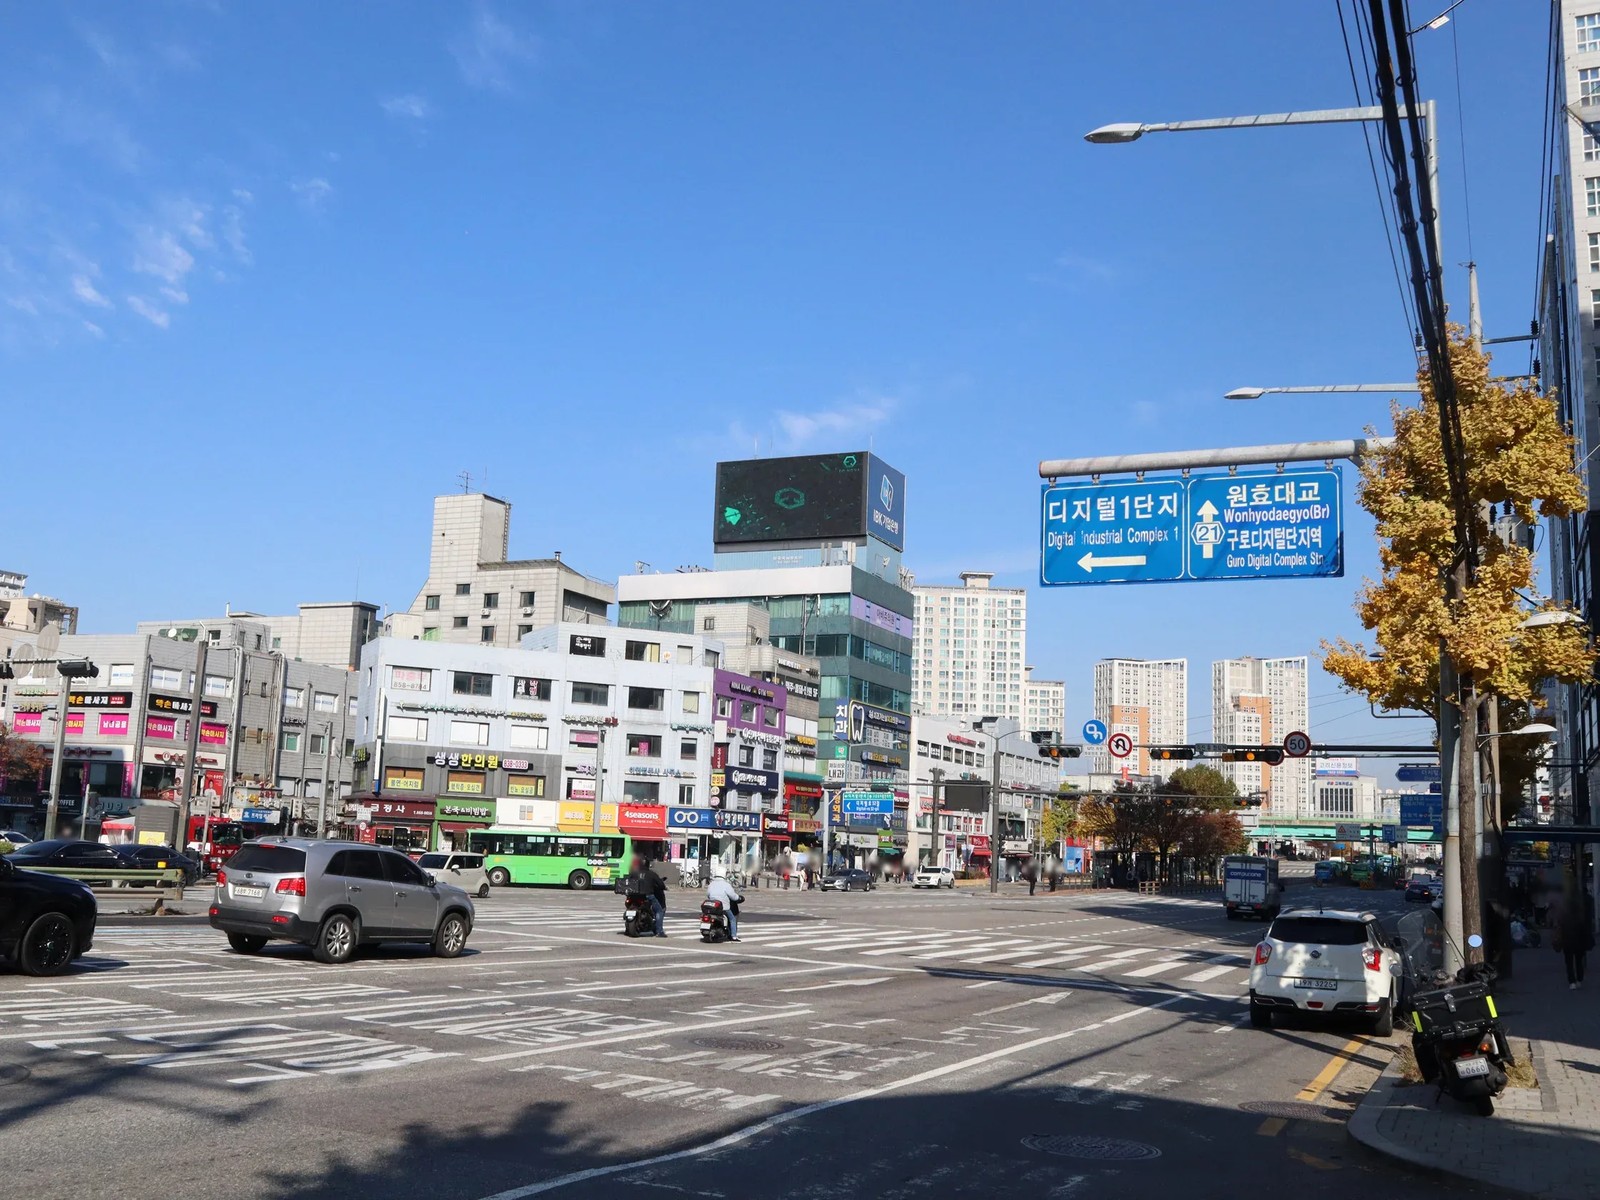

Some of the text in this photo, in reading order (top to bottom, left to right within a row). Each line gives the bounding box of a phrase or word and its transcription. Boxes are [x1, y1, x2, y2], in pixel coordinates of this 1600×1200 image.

[1226, 481, 1321, 508] 원효대교
[1049, 492, 1178, 523] 디지털1단지
[1223, 504, 1330, 525] Wonhyodaegyo(Br)
[1048, 526, 1179, 550] Digital Industrial Complex 1
[1200, 525, 1219, 541] 21
[1226, 526, 1322, 551] 구로디지털단지역
[1227, 554, 1245, 568] Guro
[1248, 552, 1272, 570] Digital
[1274, 551, 1307, 569] Complex
[835, 704, 849, 734] 치과
[1289, 738, 1306, 750] 50
[435, 752, 498, 769] 생생한의원
[828, 769, 845, 779] 내과
[624, 811, 659, 819] 4seasons
[1314, 980, 1334, 988] 3225
